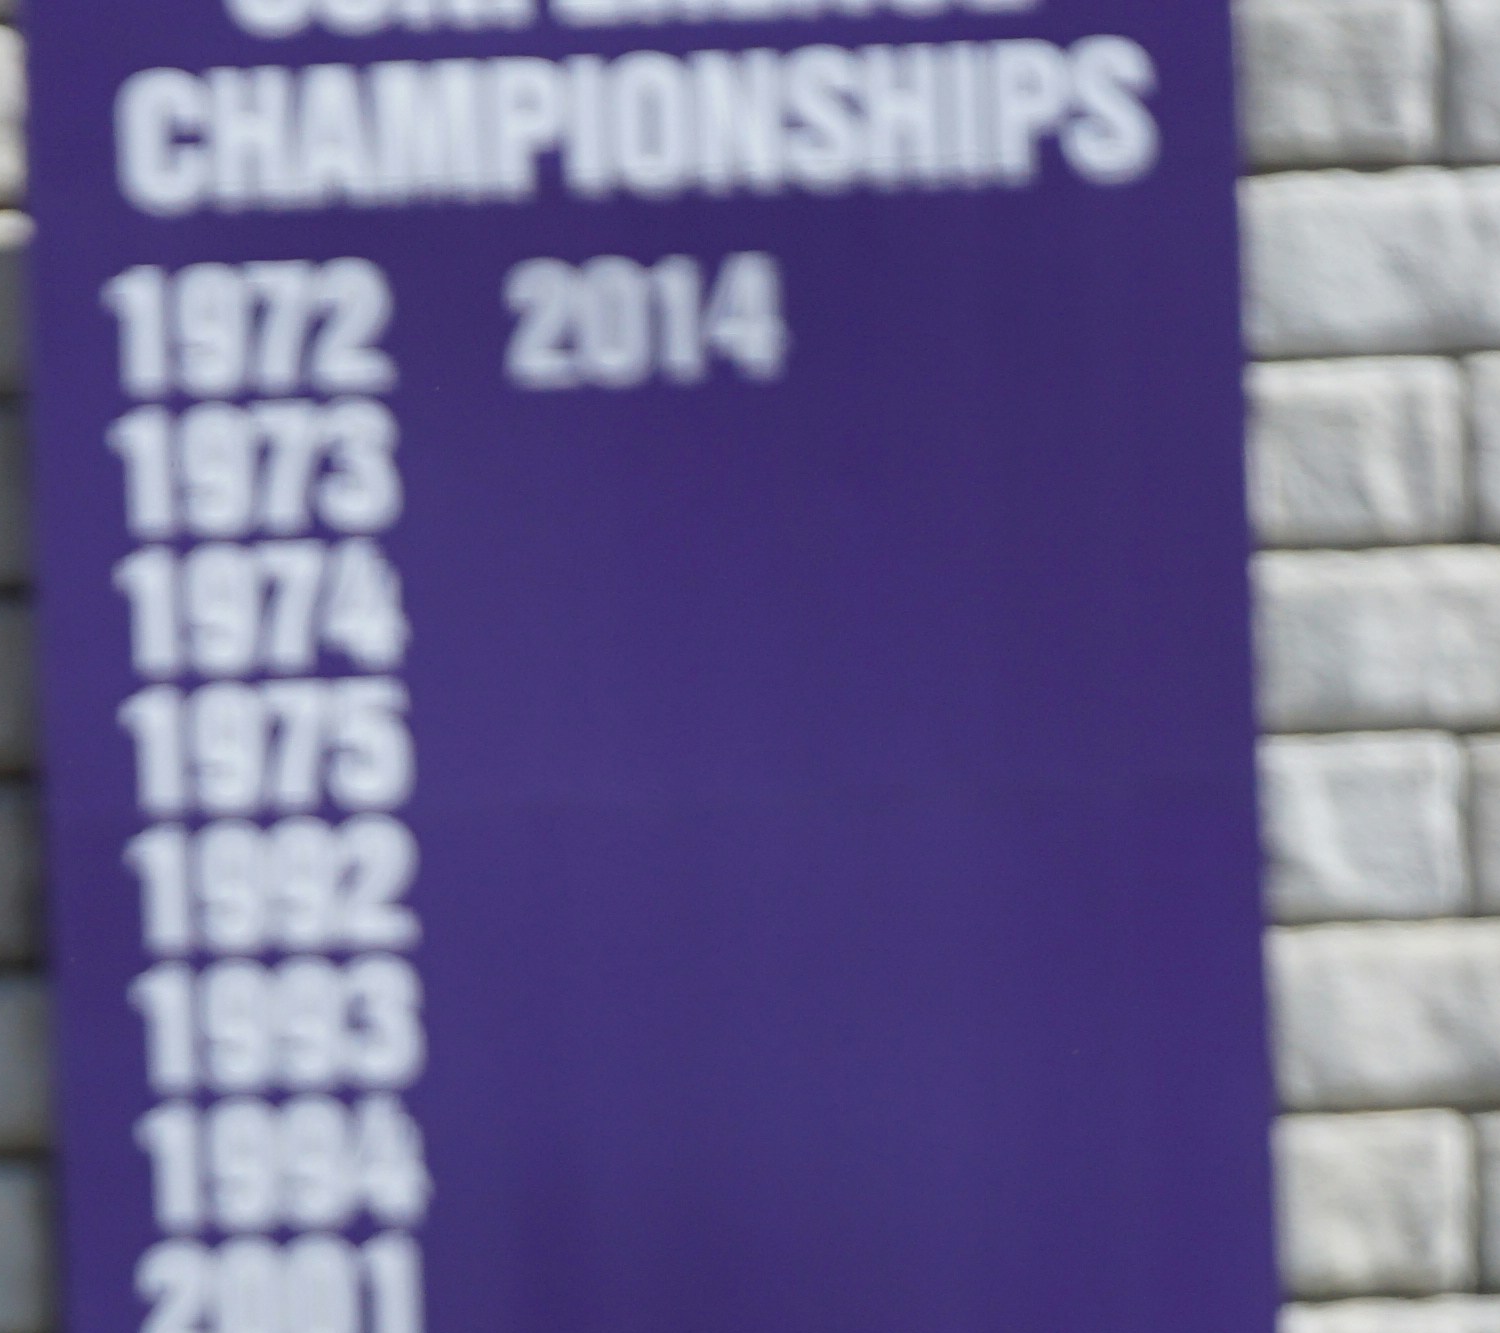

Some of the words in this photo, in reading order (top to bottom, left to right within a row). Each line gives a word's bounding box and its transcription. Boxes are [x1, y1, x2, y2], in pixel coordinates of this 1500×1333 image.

[115, 36, 1156, 212] CHAMPIONSHIPS
[104, 258, 392, 394] 1972
[505, 252, 784, 386] 2014
[108, 400, 400, 536] 1973
[113, 540, 407, 675] 1974
[118, 678, 413, 815] 1975
